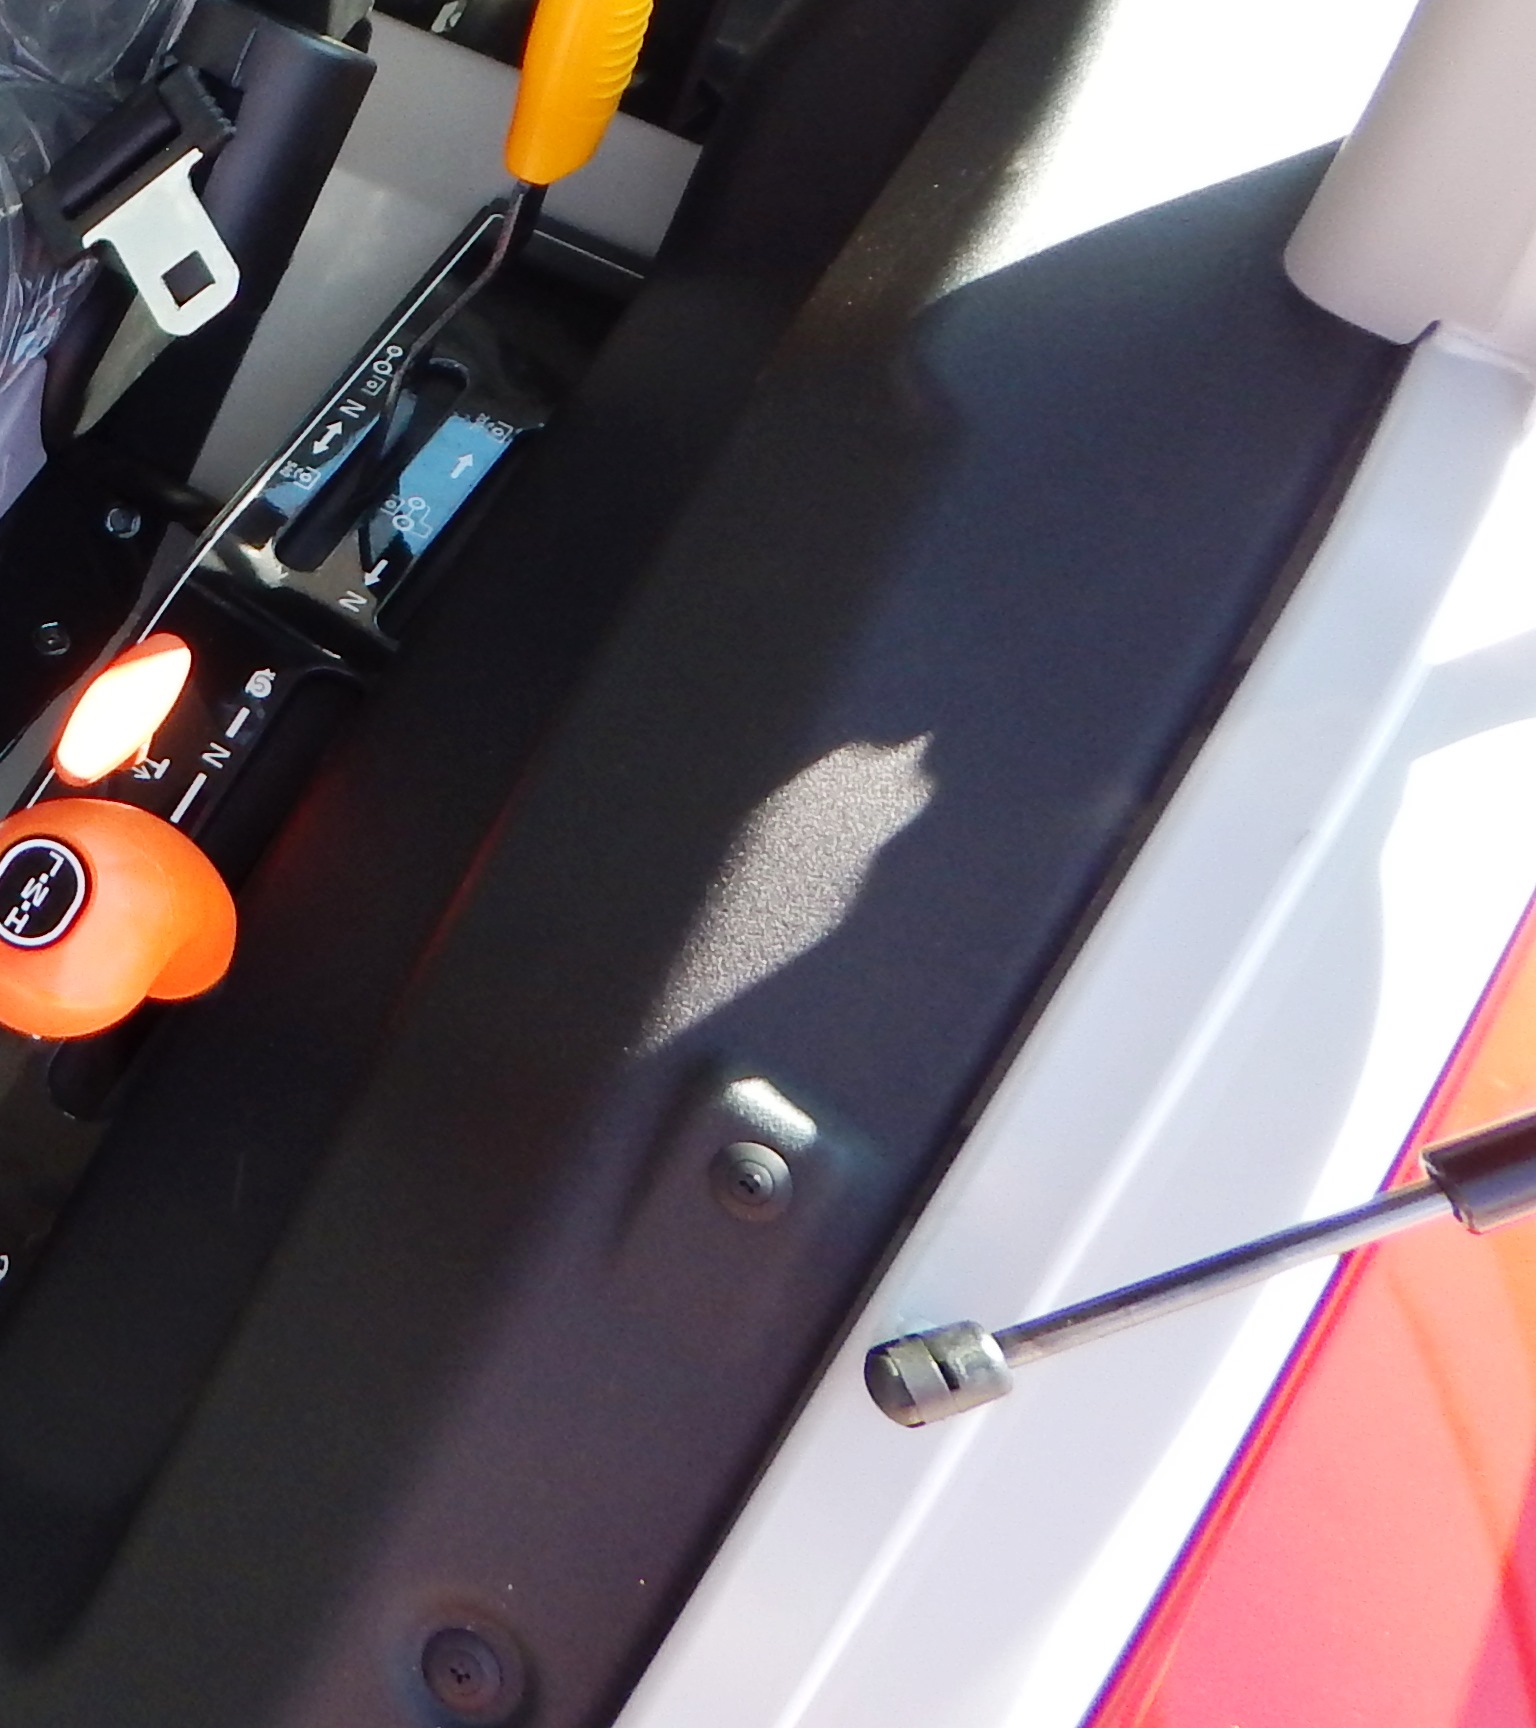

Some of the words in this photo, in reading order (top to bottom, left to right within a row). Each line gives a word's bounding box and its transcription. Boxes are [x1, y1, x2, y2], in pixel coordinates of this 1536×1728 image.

[339, 399, 366, 419] N
[338, 590, 367, 613] N
[202, 742, 231, 769] N
